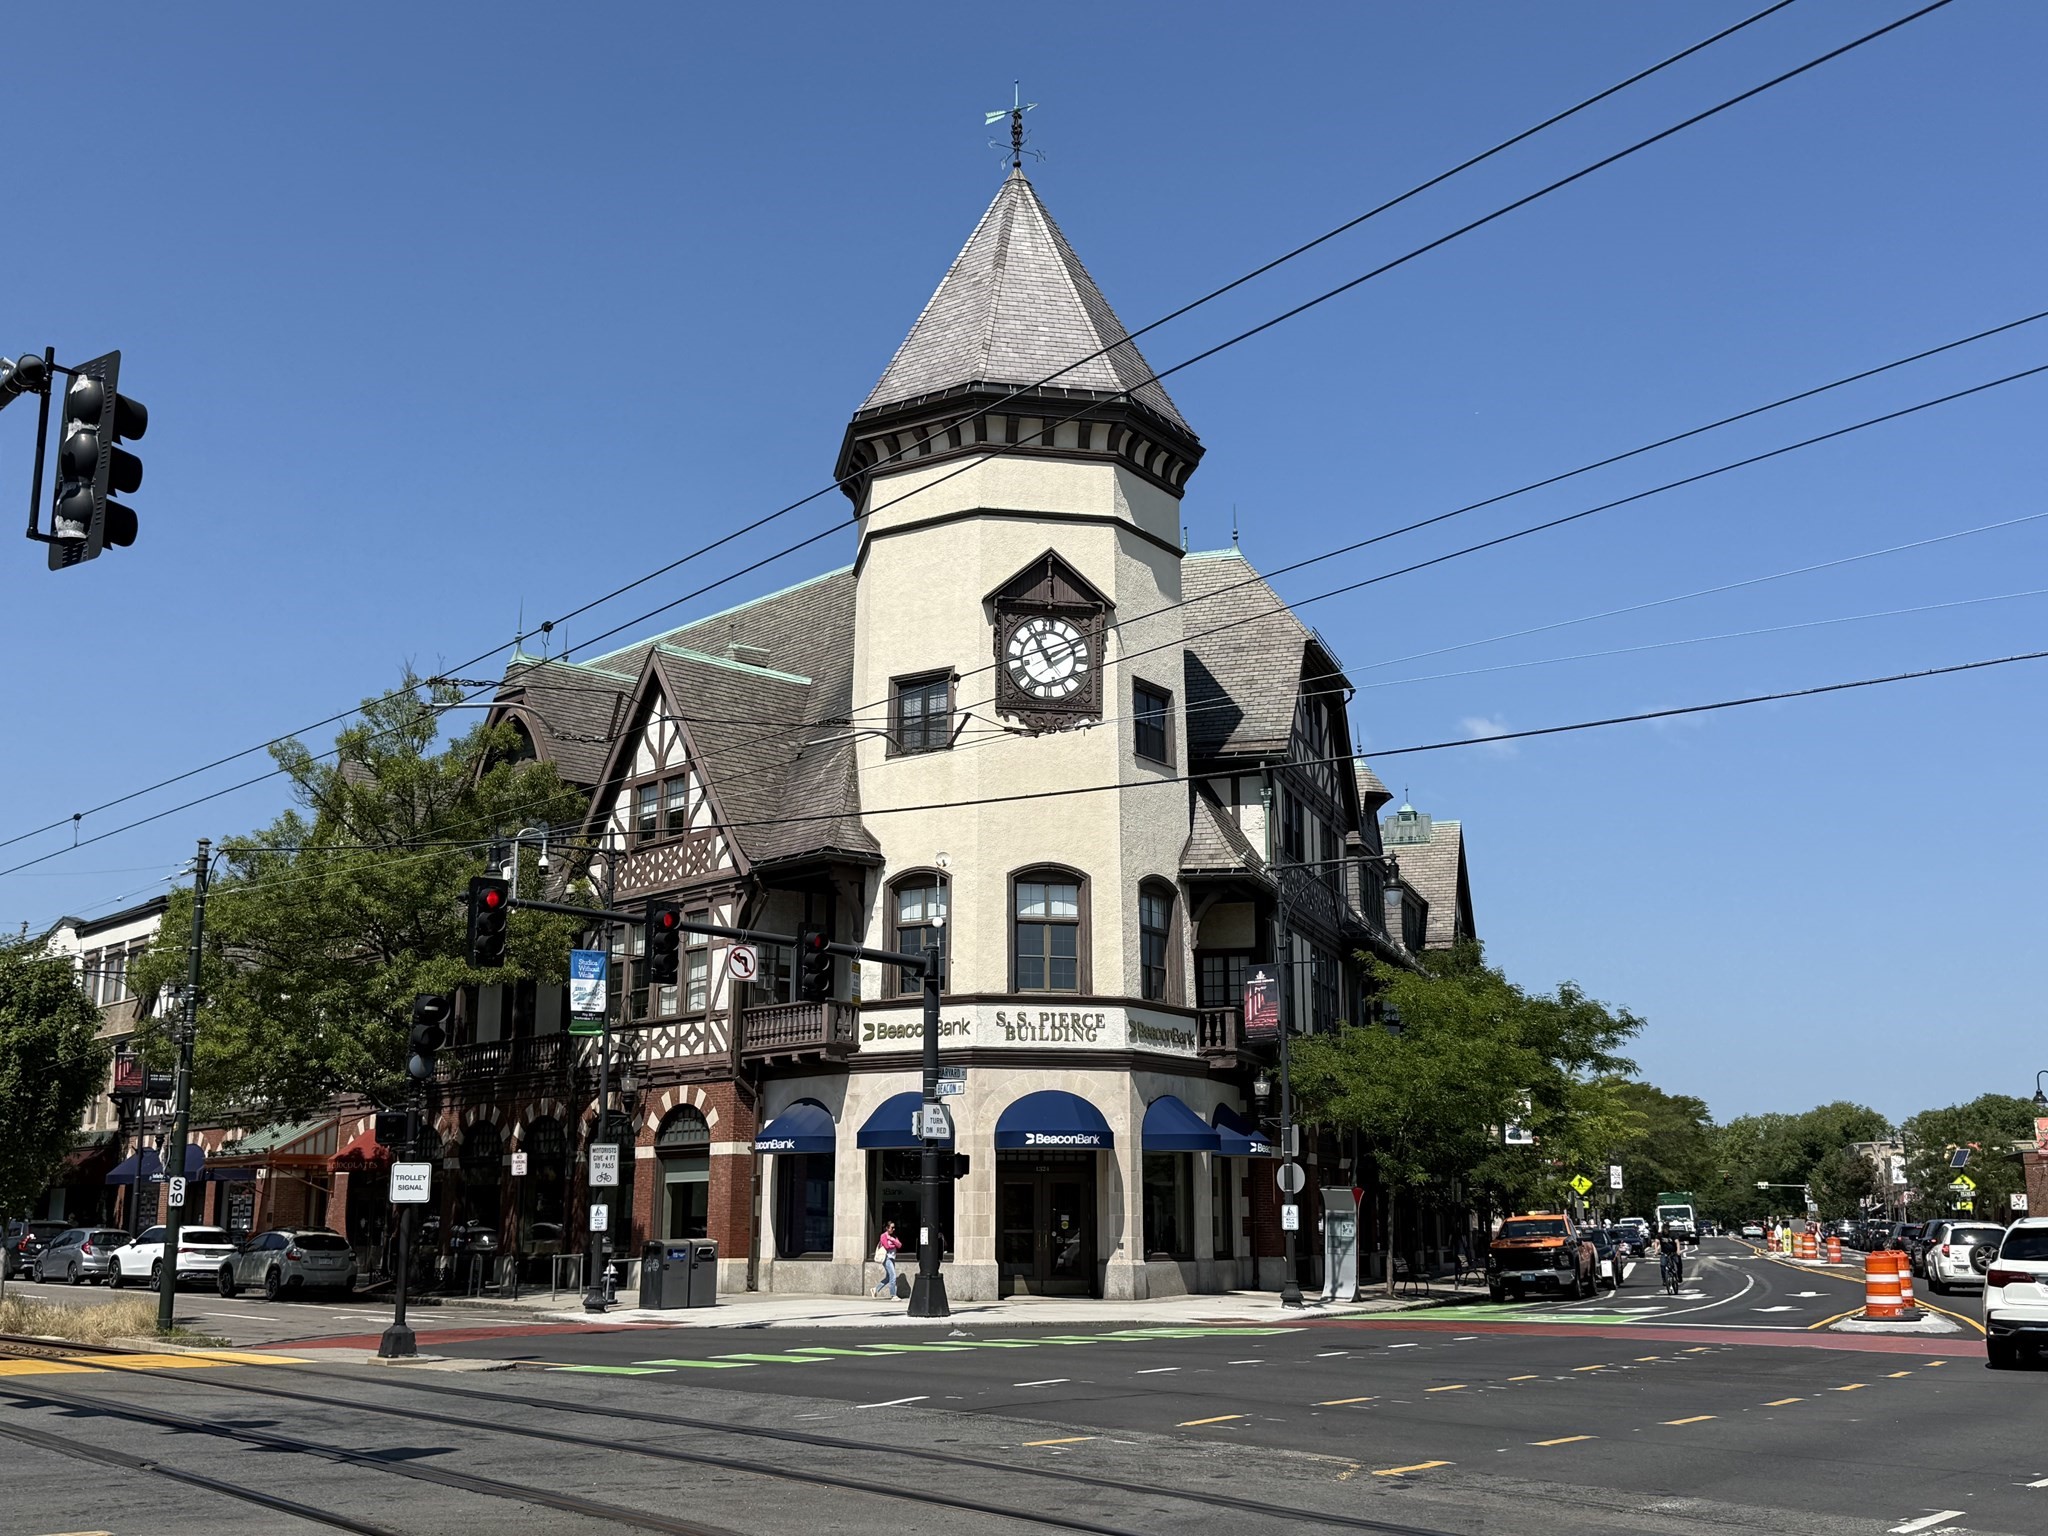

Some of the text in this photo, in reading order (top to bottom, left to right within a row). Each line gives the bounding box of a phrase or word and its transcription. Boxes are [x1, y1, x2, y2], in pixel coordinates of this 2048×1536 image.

[996, 1011, 1106, 1029] S. S. PIERCE
[877, 1017, 970, 1040] BeacoBank
[1005, 1025, 1098, 1042] BUILDING
[1137, 1021, 1195, 1046] BeaconBank
[938, 1083, 957, 1094] BEACON
[933, 1107, 940, 1115] NO
[1035, 1133, 1100, 1144] BeaconBank
[173, 1180, 182, 1191] S
[170, 1193, 183, 1204] 10
